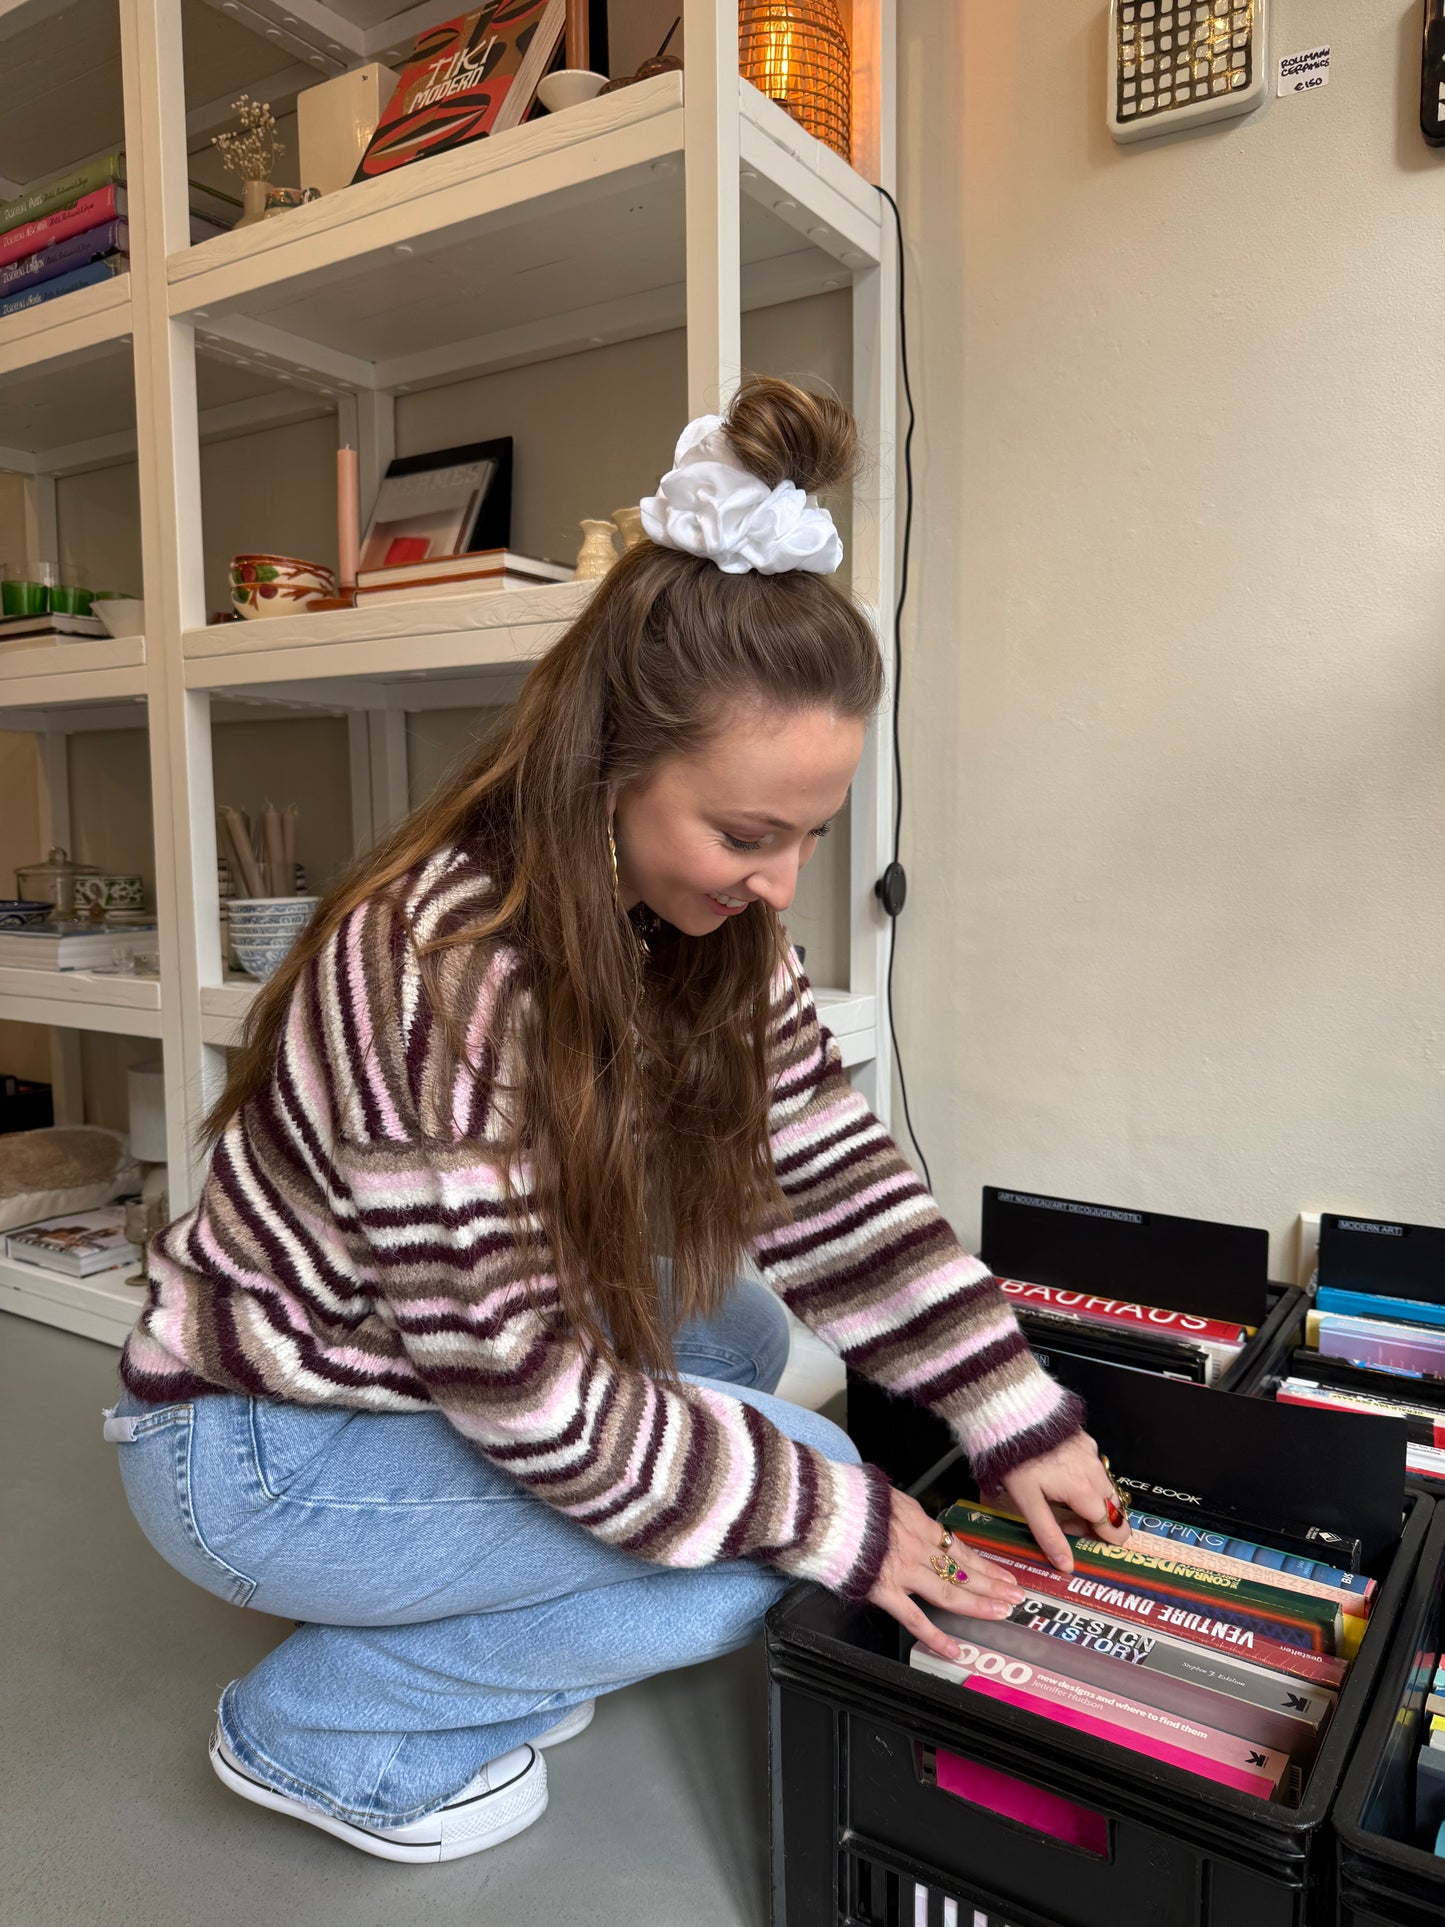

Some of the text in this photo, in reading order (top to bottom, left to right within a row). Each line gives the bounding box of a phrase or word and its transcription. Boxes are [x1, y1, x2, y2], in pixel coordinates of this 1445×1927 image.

[427, 35, 498, 88] TIKI
[1281, 48, 1330, 69] ROLLMANN
[1281, 58, 1330, 77] CERAMICS
[408, 65, 486, 114] MODERN
[1294, 77, 1323, 91] €150
[1000, 1192, 1015, 1202] ART
[1340, 1220, 1401, 1235] MODERN ART
[1001, 1279, 1209, 1330] BAUHAUS
[1117, 1476, 1203, 1505] RCE BOOK
[1128, 1510, 1226, 1547] HOPPING
[1095, 1541, 1178, 1573] DESIGN
[1173, 1567, 1231, 1588] CONRAN
[1340, 1572, 1355, 1585] BIS
[1067, 1577, 1156, 1616] ONWARD
[1028, 1615, 1149, 1665] HISTORY
[1053, 1609, 1157, 1653] DESIGN
[1158, 1605, 1254, 1649] VENTURE
[1181, 1661, 1208, 1674] Stephen
[1280, 1644, 1323, 1663] gestalten
[952, 1643, 1208, 1739] 000 new designs and where to find them
[1032, 1680, 1104, 1711] Jennifer Hudson
